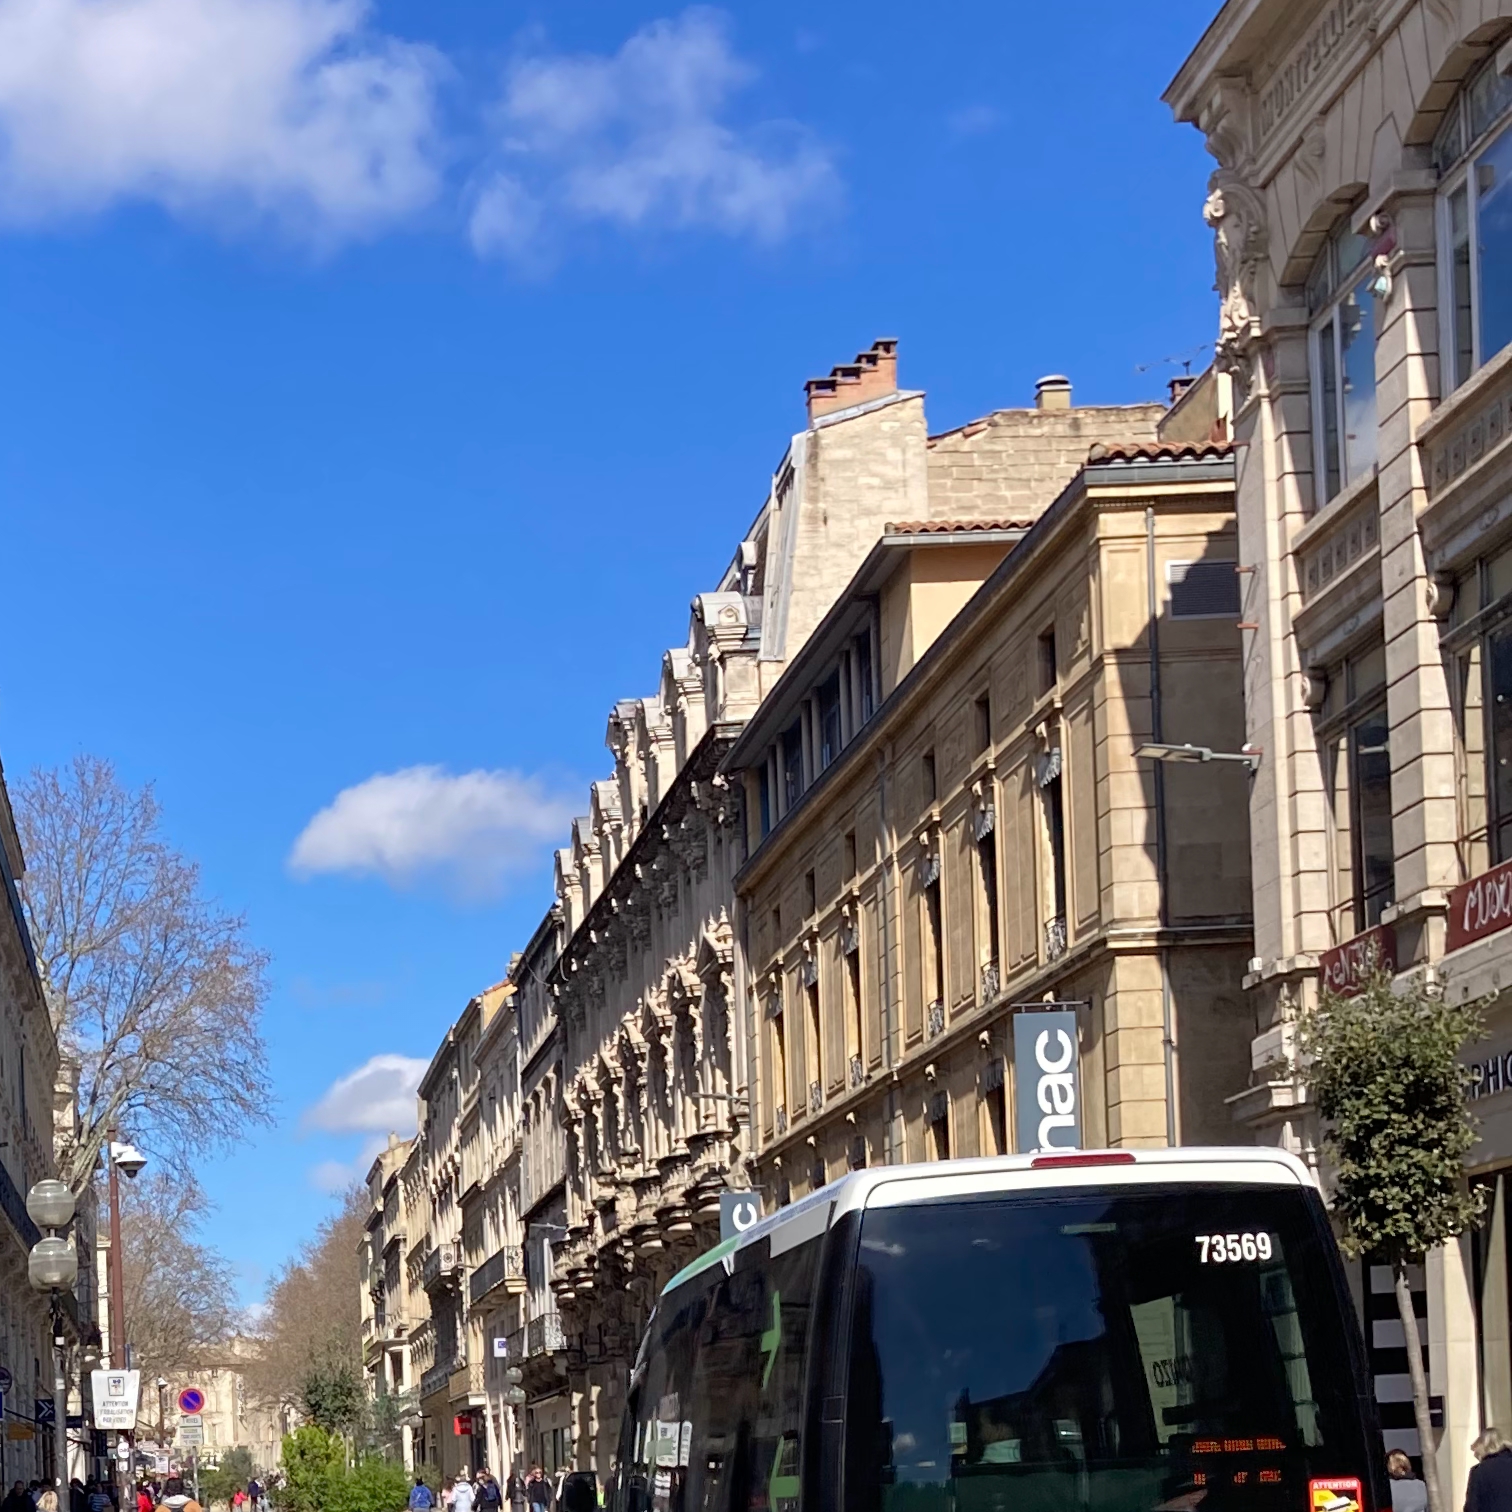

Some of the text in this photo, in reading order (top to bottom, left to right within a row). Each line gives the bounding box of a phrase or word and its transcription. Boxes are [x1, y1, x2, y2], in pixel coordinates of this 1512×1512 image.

[1029, 1028, 1076, 1154] nac
[1195, 1232, 1272, 1263] 73569
[1313, 1481, 1358, 1490] ATTENTION
